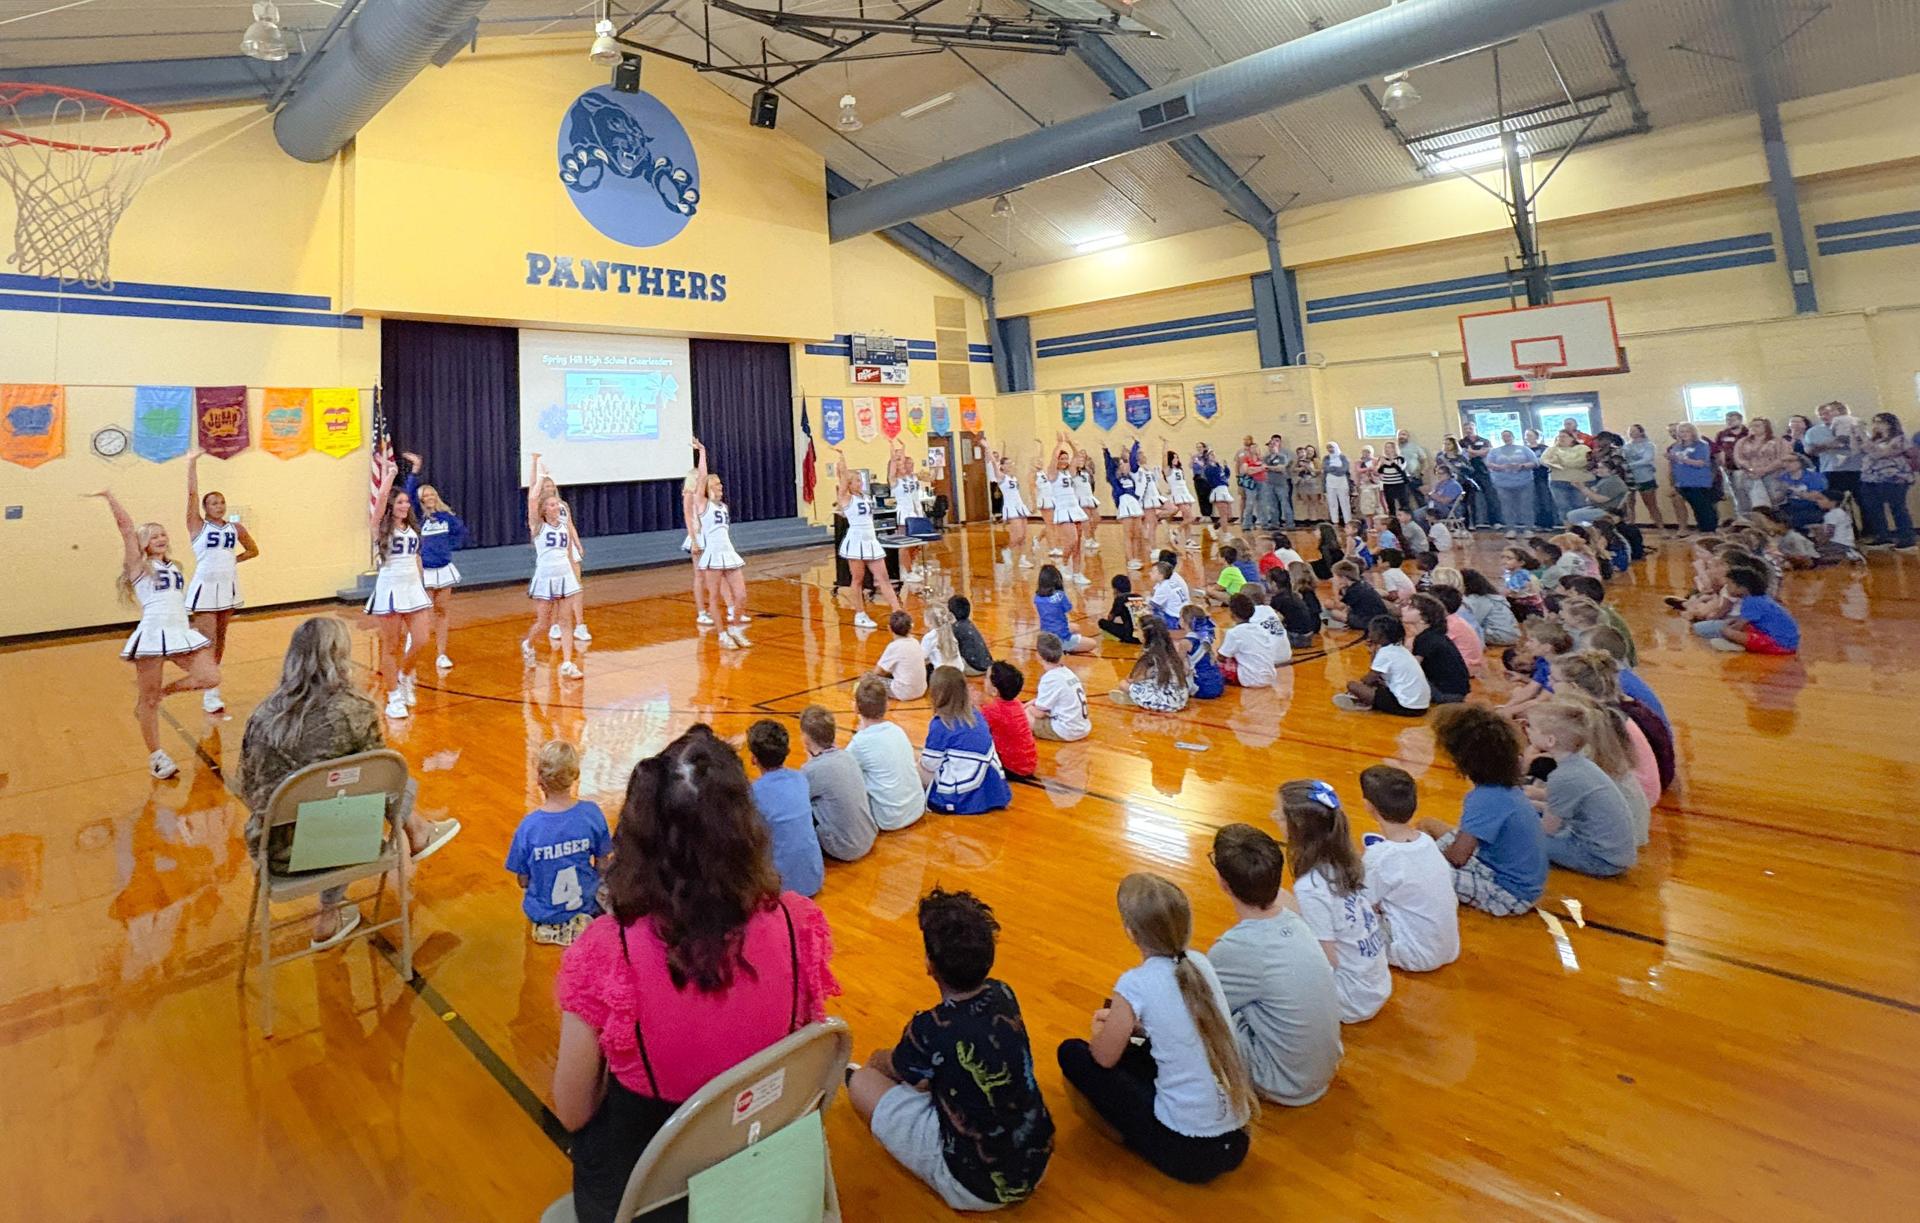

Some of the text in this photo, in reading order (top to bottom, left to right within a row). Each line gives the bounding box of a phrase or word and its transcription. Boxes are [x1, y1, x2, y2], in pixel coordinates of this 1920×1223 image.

[525, 252, 728, 303] PANTHERS
[542, 354, 673, 366] Spring Hill High School Cheerleaders
[533, 838, 591, 861] FRASER
[551, 865, 584, 912] 4
